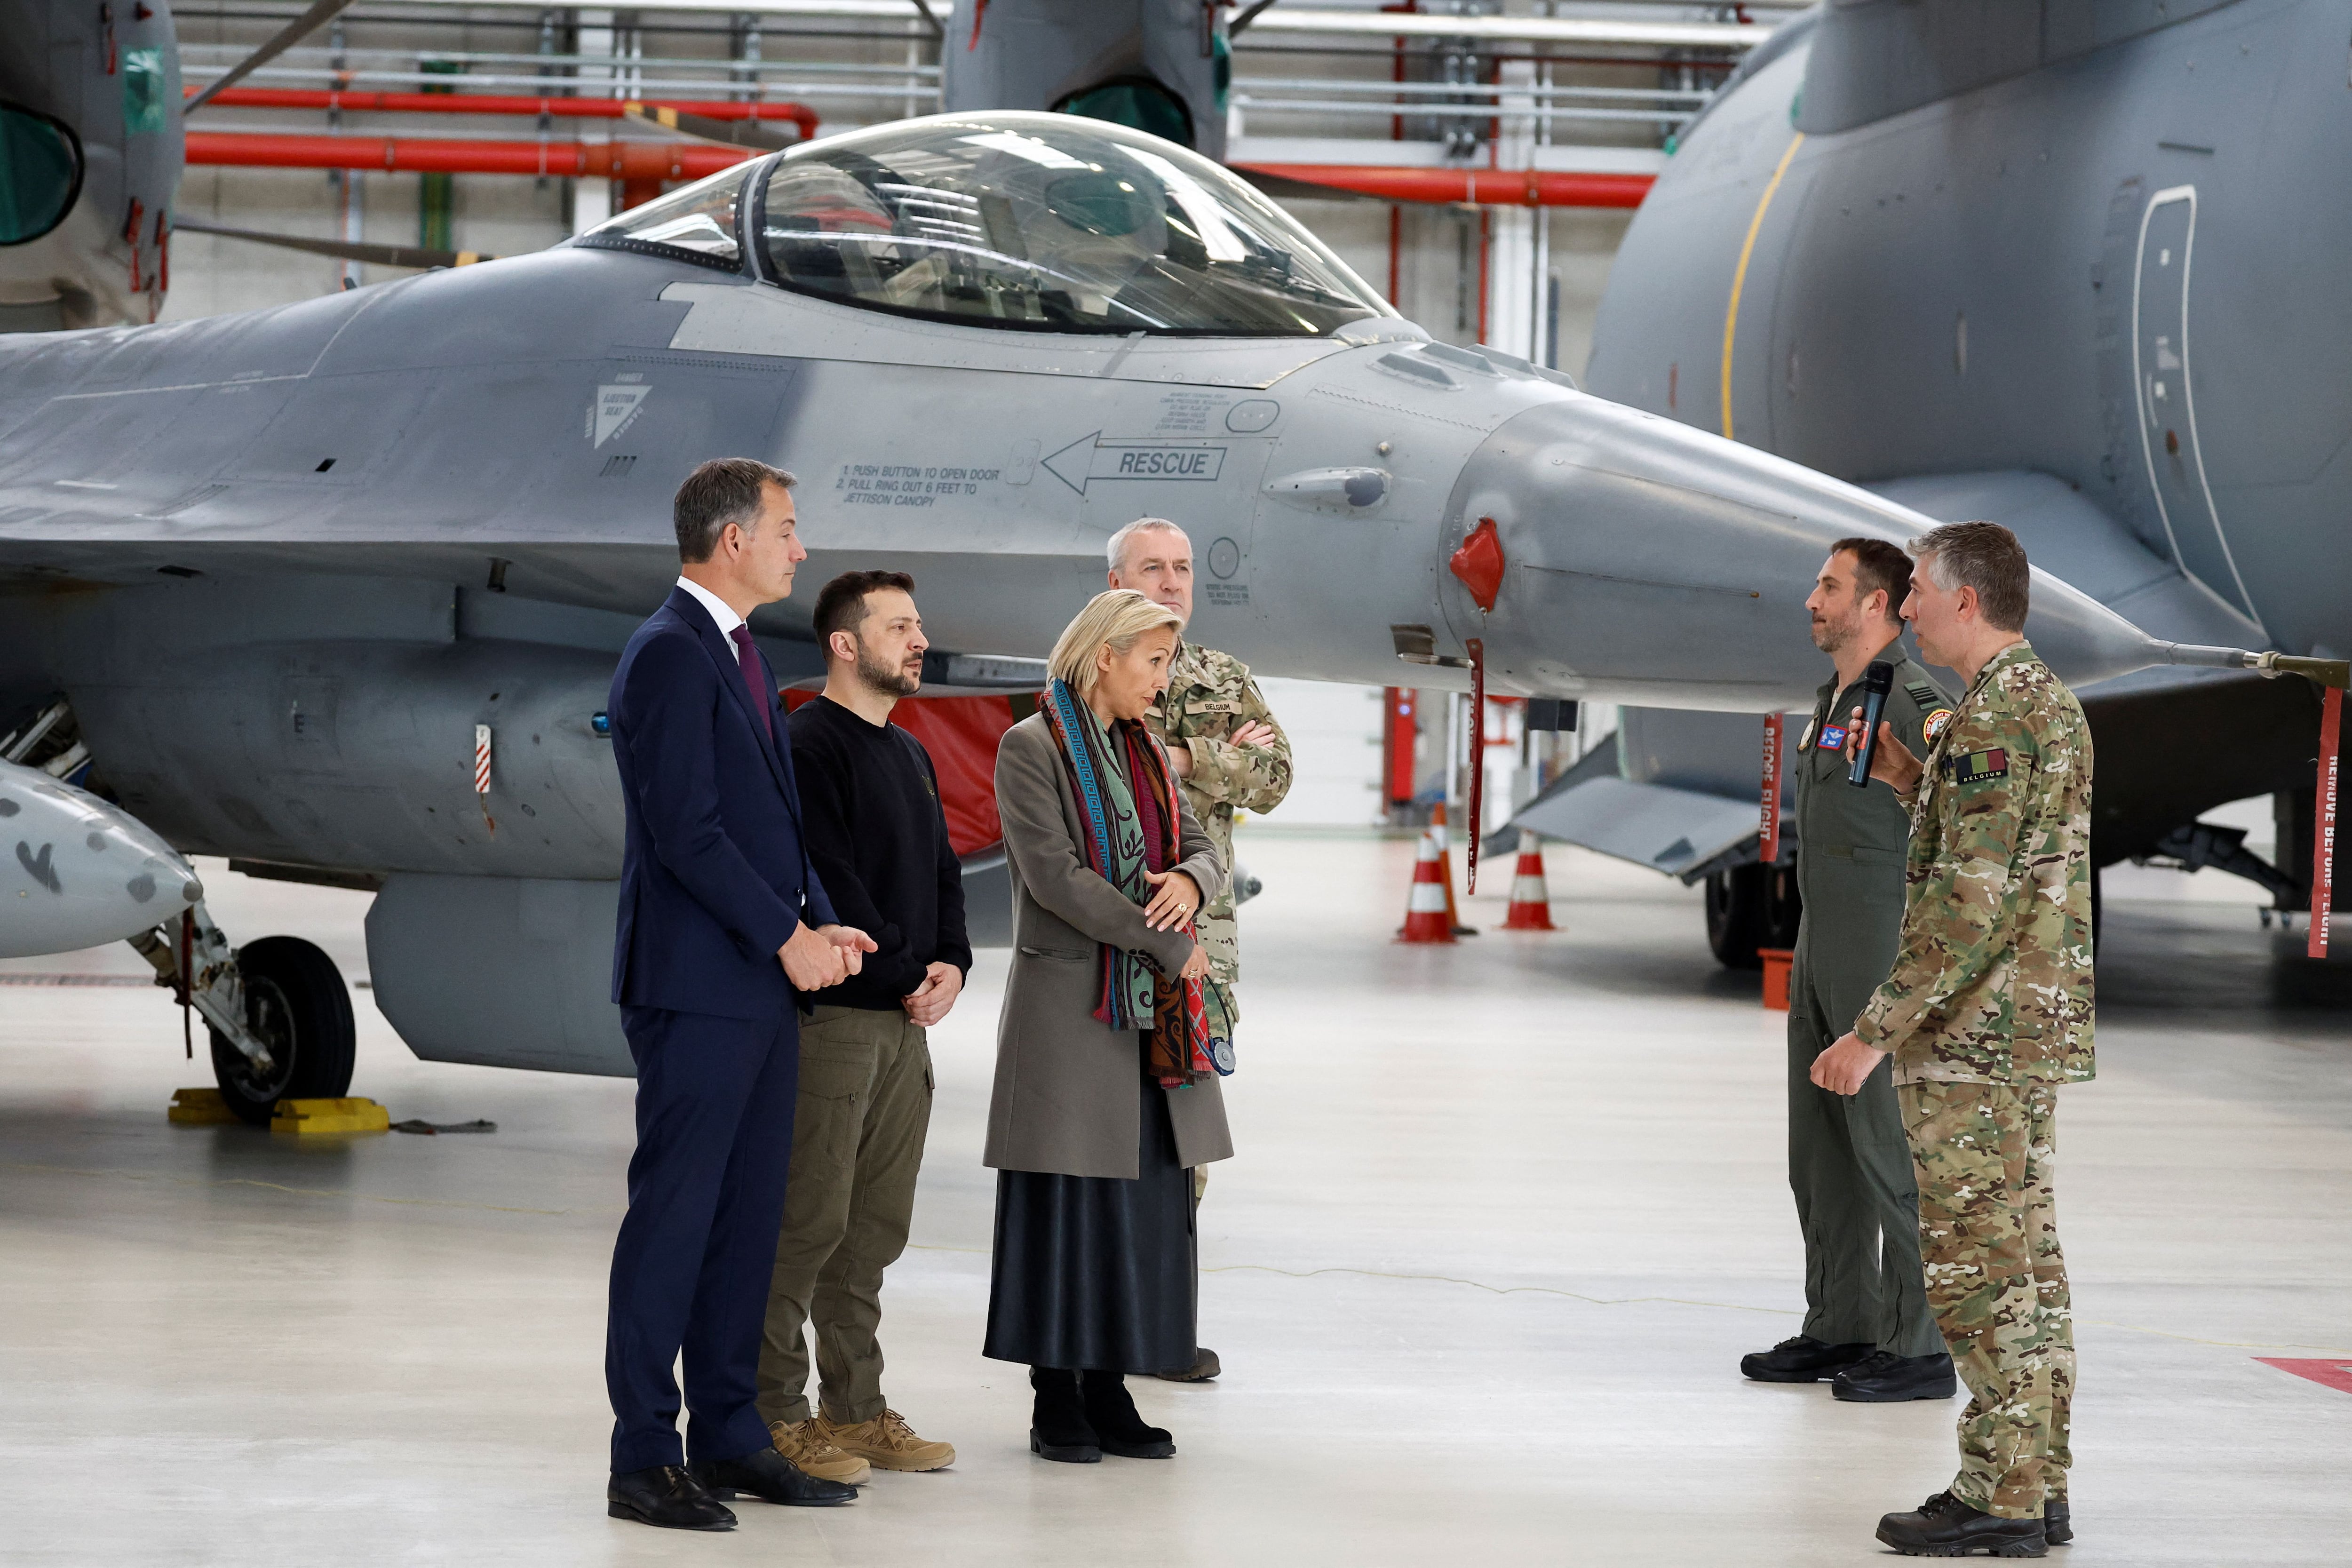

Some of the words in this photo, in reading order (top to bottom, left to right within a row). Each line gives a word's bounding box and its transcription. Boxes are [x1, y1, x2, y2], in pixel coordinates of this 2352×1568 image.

[1119, 452, 1209, 474] RESCUE
[852, 465, 879, 476] PUSH
[882, 466, 922, 478] BUTTON
[925, 467, 937, 478] TO
[940, 468, 967, 479] OPEN
[969, 469, 999, 480] DOOR
[848, 478, 871, 490] PULL
[875, 480, 898, 492] RING
[902, 481, 923, 492] OUT
[926, 482, 933, 493] 6
[936, 482, 961, 494] FEET
[964, 483, 977, 495] TO
[843, 492, 892, 505] JETTISON
[895, 494, 936, 507] CANOPY
[1930, 712, 1944, 723] FLIGHT
[1963, 771, 2001, 782] BELGIUM
[1760, 789, 1773, 840] FLIGHT
